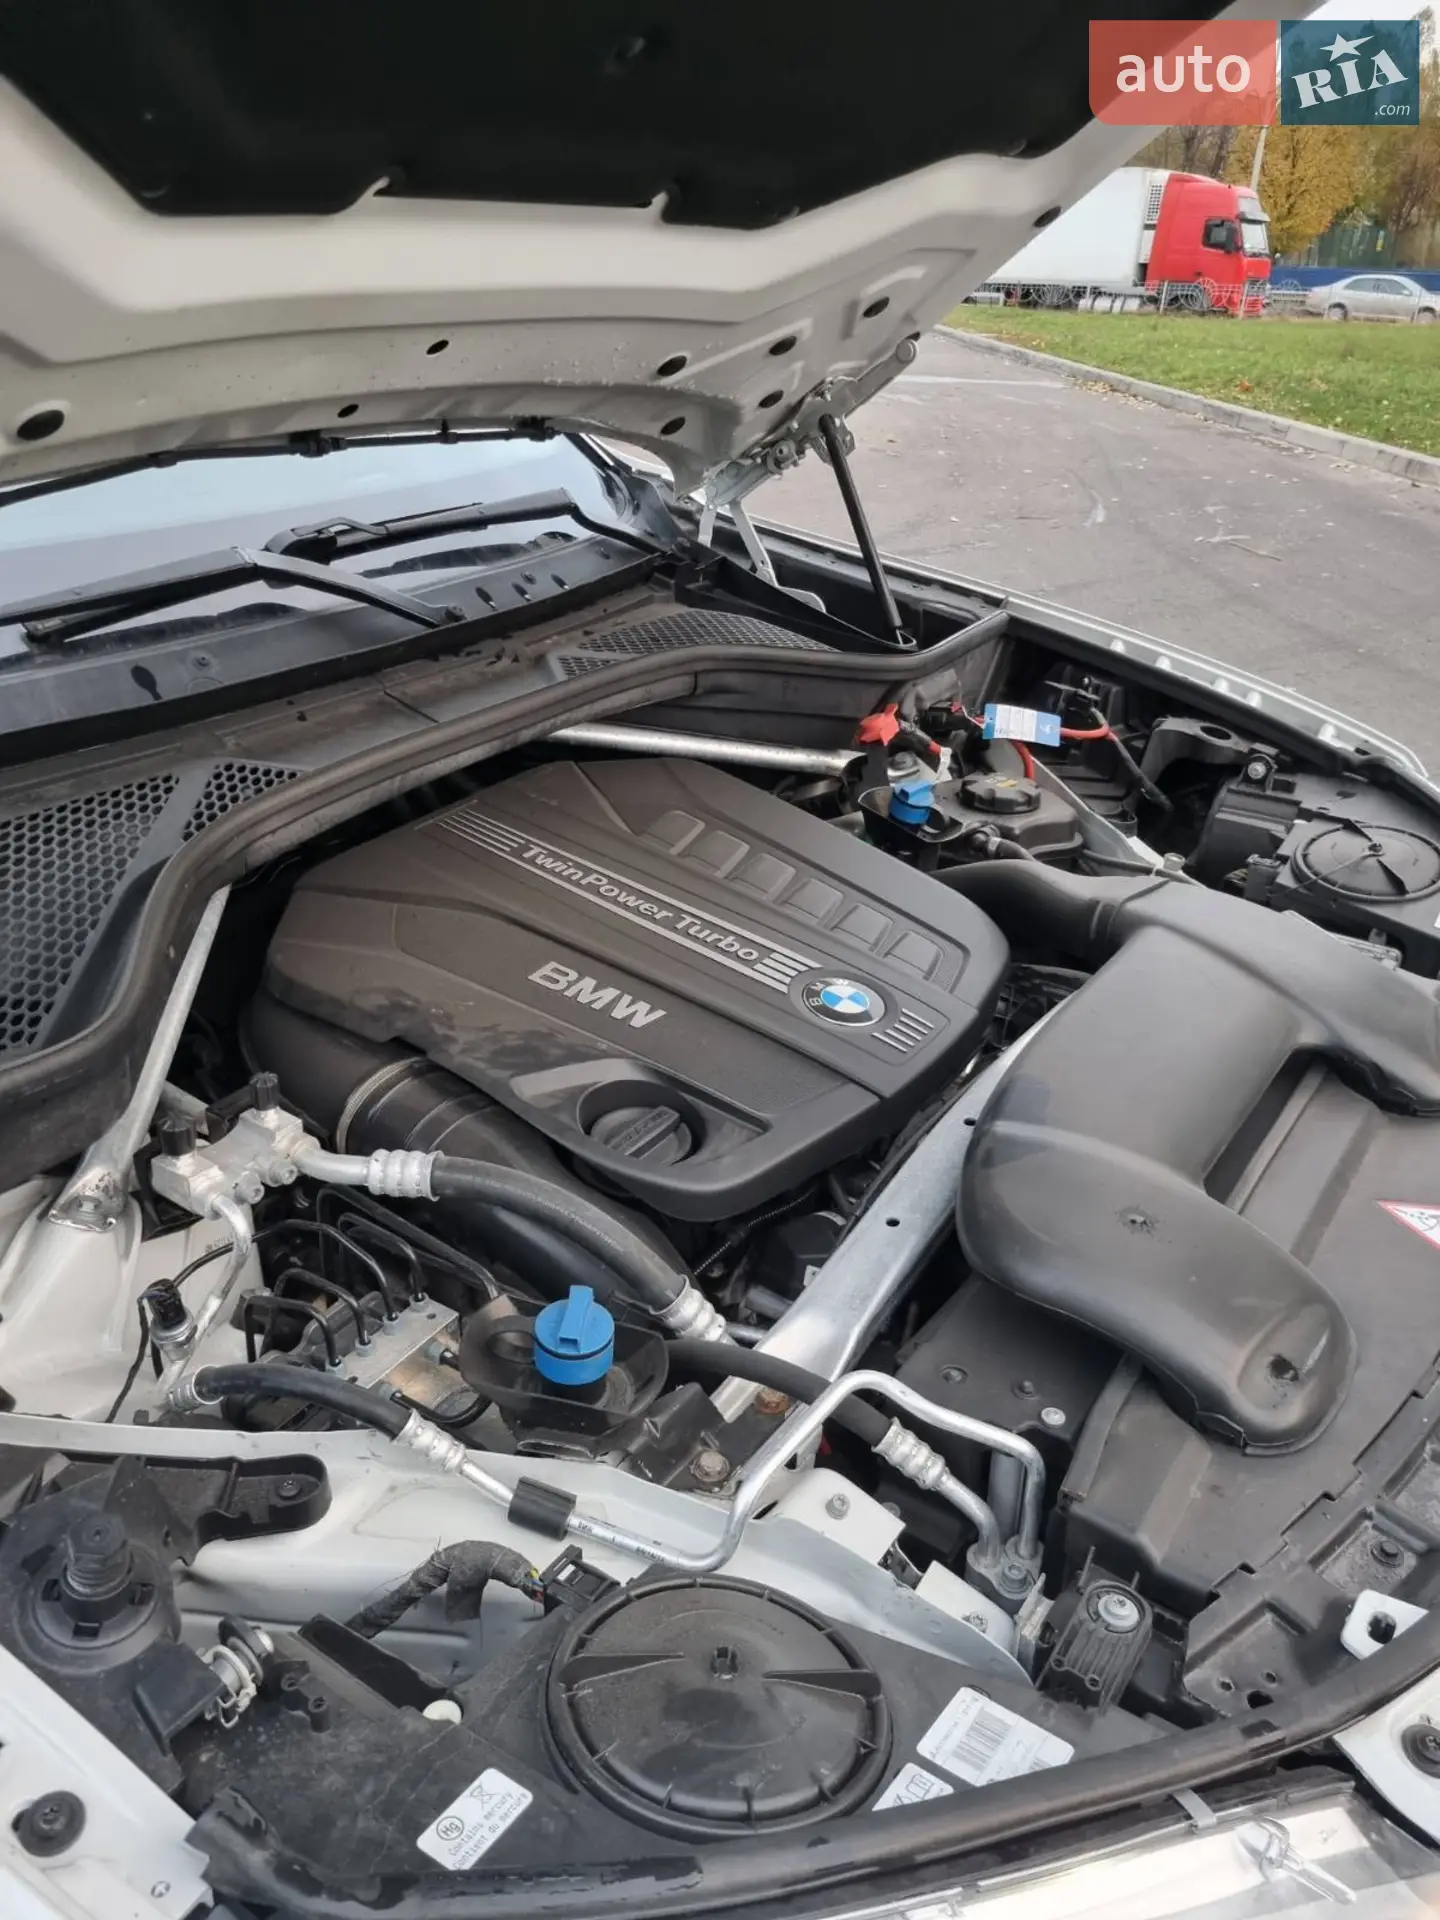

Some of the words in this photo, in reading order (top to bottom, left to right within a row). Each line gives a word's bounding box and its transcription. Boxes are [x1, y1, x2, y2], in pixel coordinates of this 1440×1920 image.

[522, 844, 674, 922] TwinPower
[674, 913, 760, 962] Turbo
[527, 960, 667, 1029] BMW
[440, 1821, 461, 1837] Hg
